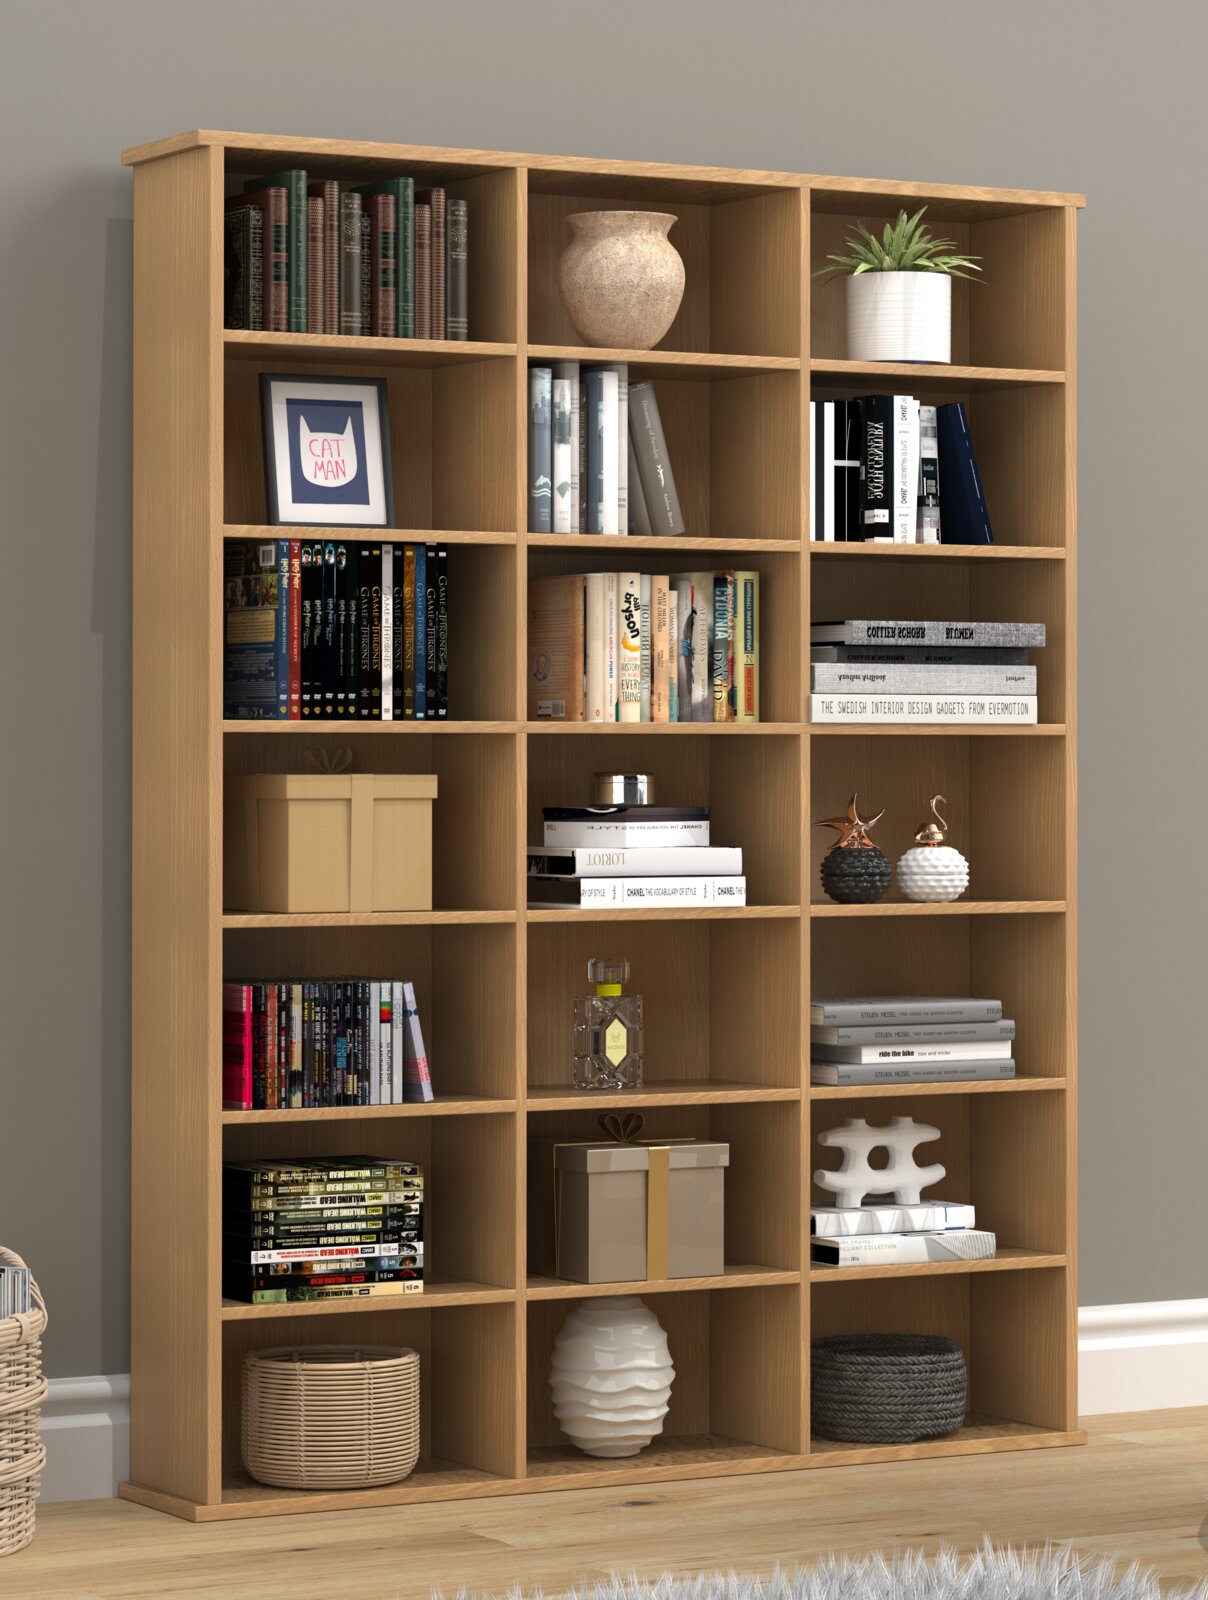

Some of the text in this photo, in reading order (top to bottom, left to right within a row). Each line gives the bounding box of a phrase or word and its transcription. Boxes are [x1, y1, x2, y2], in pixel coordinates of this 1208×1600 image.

[642, 400, 651, 429] Dreaming
[650, 437, 660, 459] Sweden
[309, 439, 344, 457] CAT
[314, 460, 346, 480] MAN
[361, 587, 370, 671] GAME THRONES
[372, 586, 381, 671] GAME THRONES
[383, 586, 392, 669] GAME THRONES
[394, 587, 402, 671] GAME THRONES
[404, 587, 413, 670] GAME THRONES
[439, 576, 447, 657] GAME THRONES
[621, 592, 640, 638] bryson
[715, 587, 728, 639] CYDONIA
[426, 589, 436, 672] GAME THRONES
[642, 604, 650, 692] ПОНТИЙ ПИЛАТ
[713, 651, 723, 701] DAVID
[622, 692, 640, 702] THING
[821, 701, 1028, 715] THE SWEDISH INTERIOR DESIGN GADGETS FROM EVERMOTION
[586, 853, 625, 866] LORIOT
[594, 889, 606, 897] STYLE
[627, 888, 644, 896] CHANEL
[653, 888, 678, 896] VOCABULARY
[685, 887, 697, 896] STYLE
[718, 887, 735, 895] CHANEL
[344, 1182, 371, 1190] WALKING
[345, 1170, 370, 1178] WALKING
[338, 1195, 366, 1203] WALKING
[340, 1208, 366, 1216] WALKING
